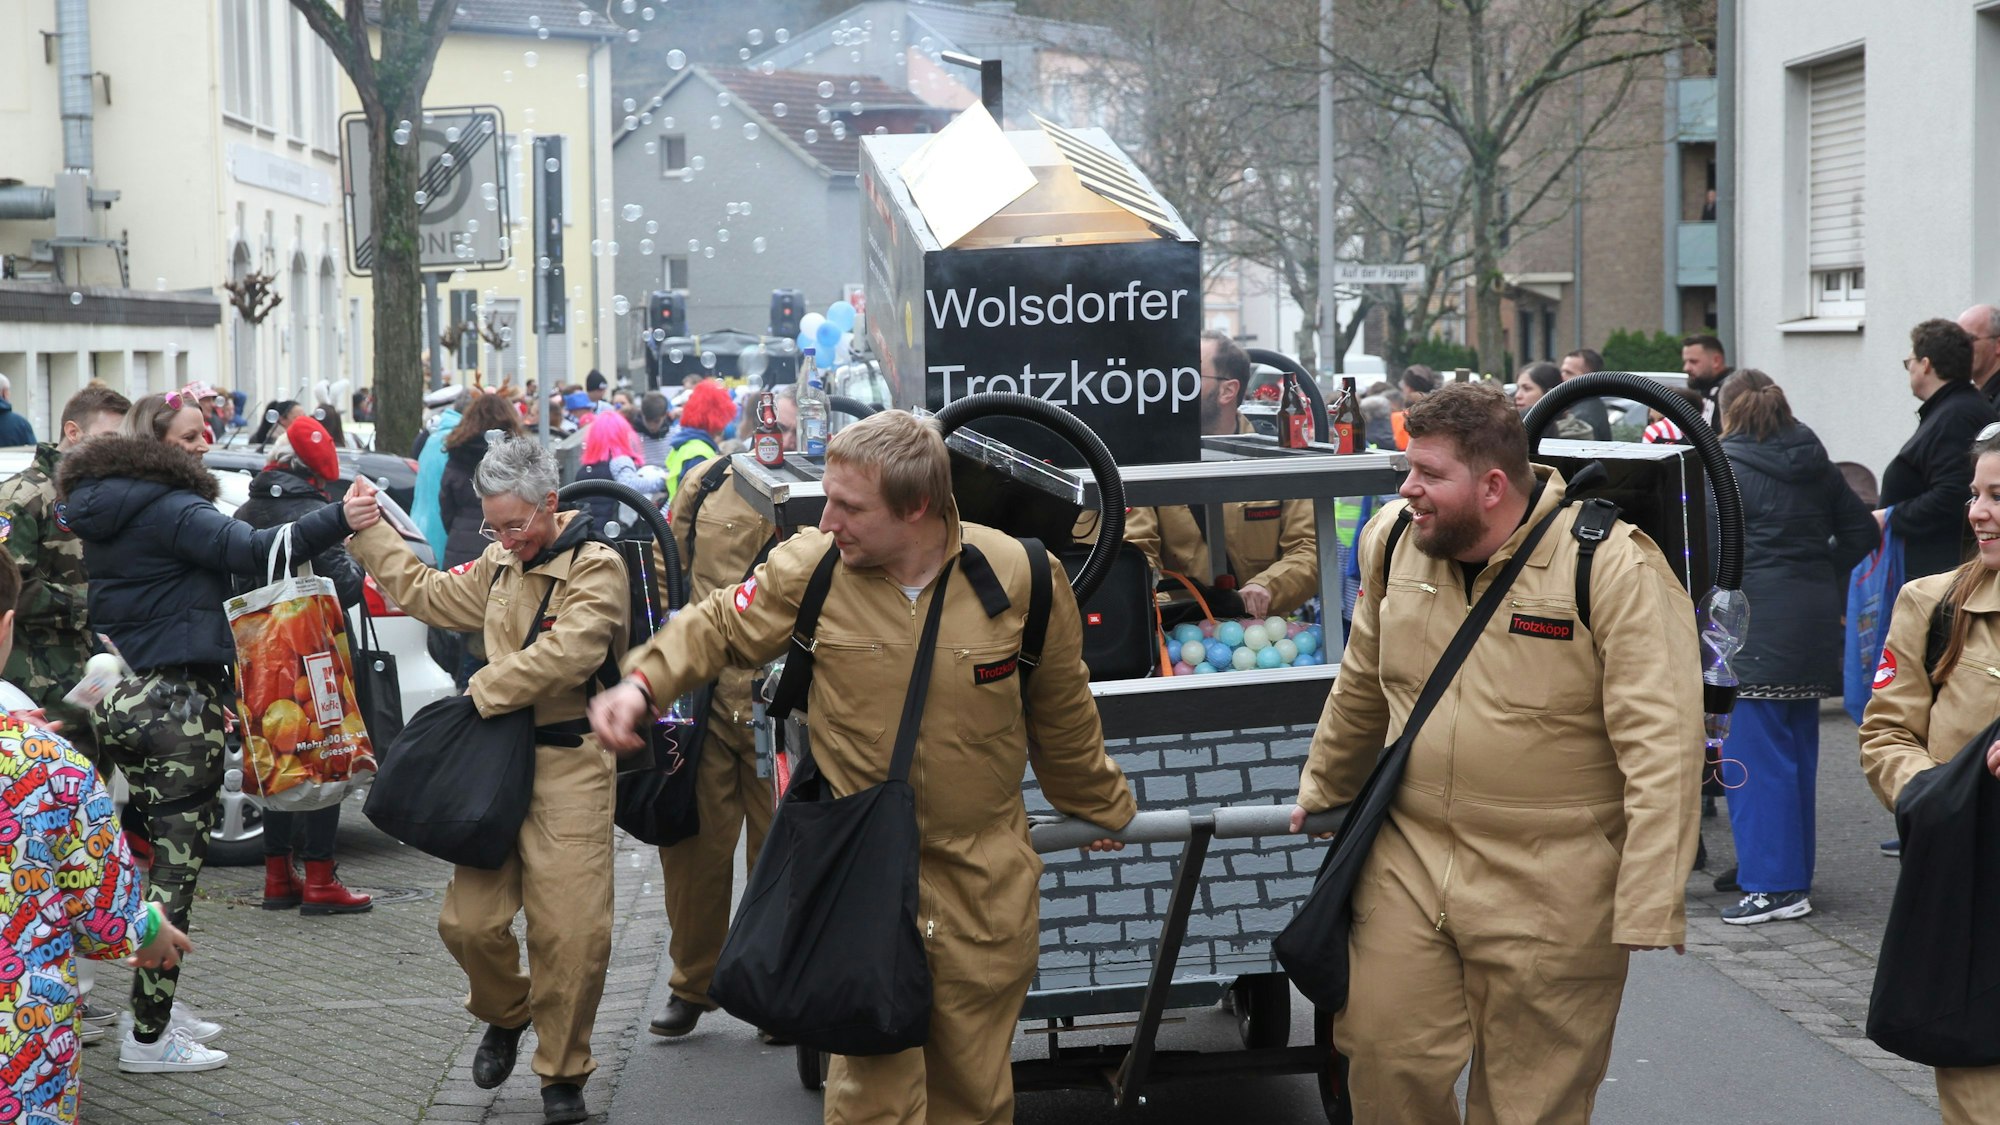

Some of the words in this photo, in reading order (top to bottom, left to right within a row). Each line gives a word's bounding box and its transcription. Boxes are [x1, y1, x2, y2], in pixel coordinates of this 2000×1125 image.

[1341, 266, 1358, 278] Auf
[1361, 267, 1377, 278] der
[925, 280, 1188, 329] Wolsdorfer
[927, 357, 1202, 415] Trotzköpp
[1513, 617, 1569, 637] Trotzköpp
[23, 738, 60, 760] OK
[87, 822, 114, 859] OK
[13, 867, 50, 893] OK
[16, 1003, 52, 1032] OK
